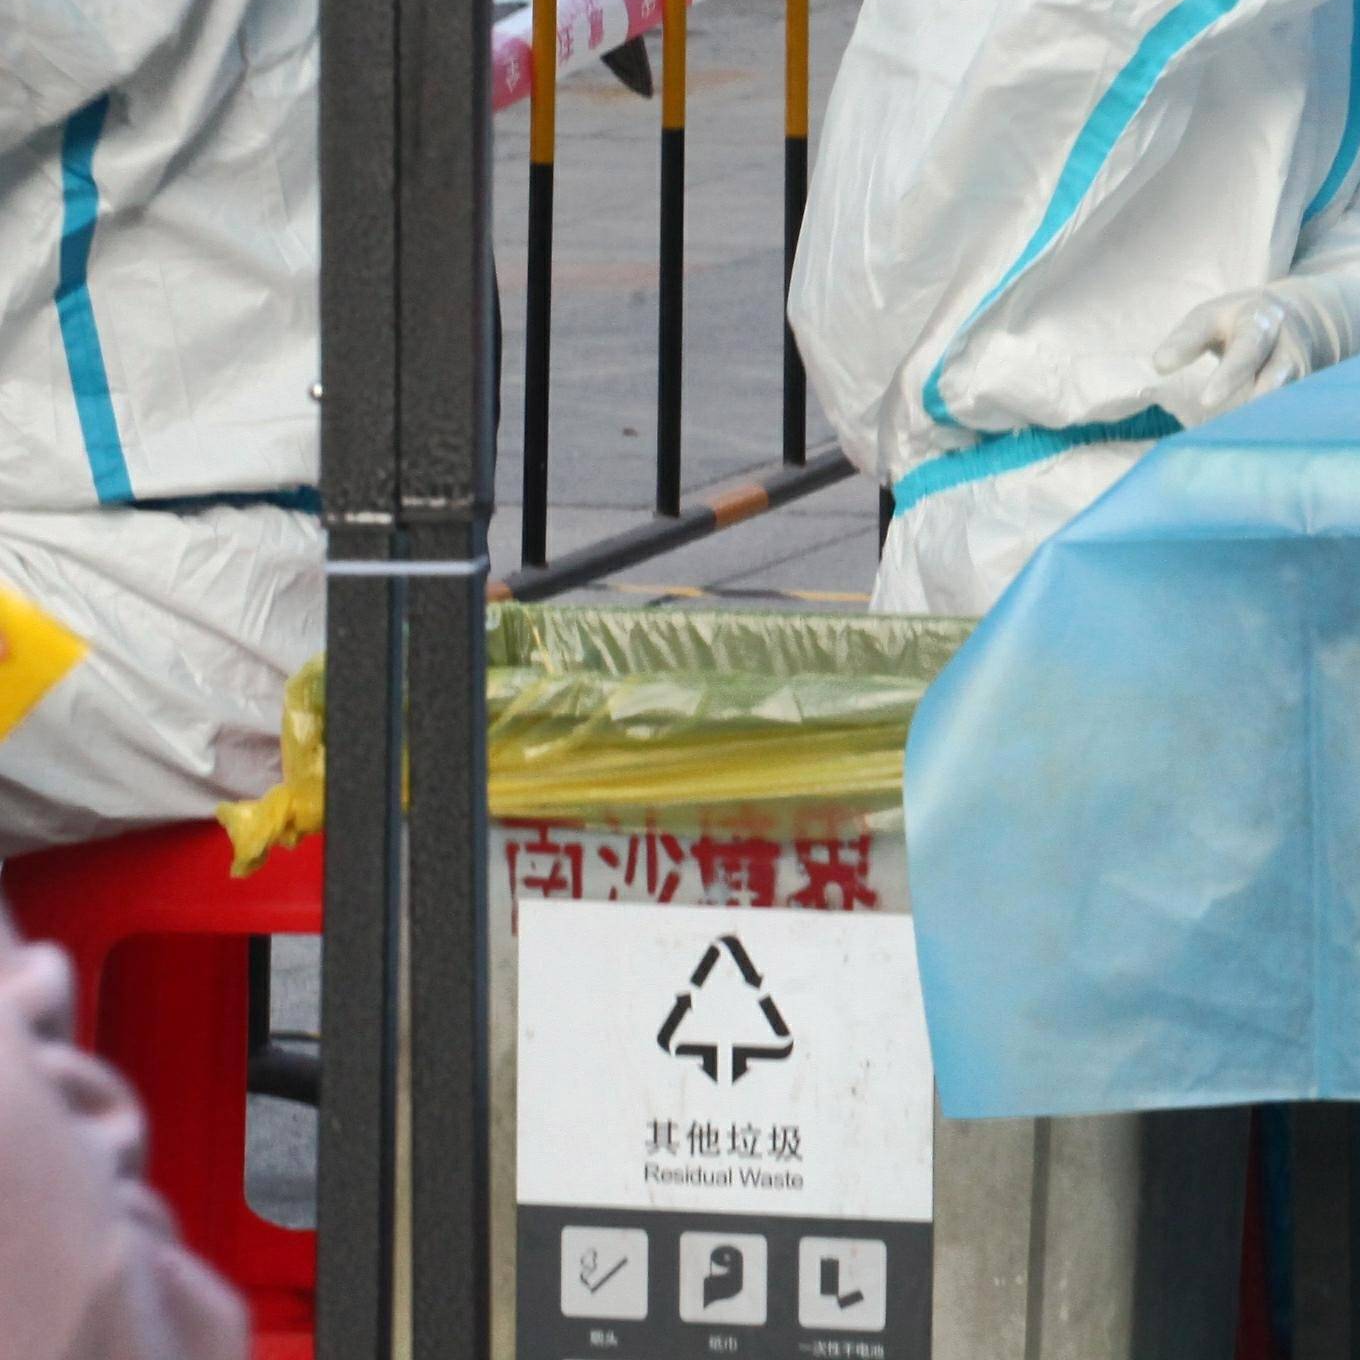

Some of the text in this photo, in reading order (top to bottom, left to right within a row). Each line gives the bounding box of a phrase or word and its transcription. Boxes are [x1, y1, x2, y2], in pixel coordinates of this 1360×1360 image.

[645, 1118, 803, 1161] 其他垃圾
[644, 1163, 804, 1190] Residual Waste
